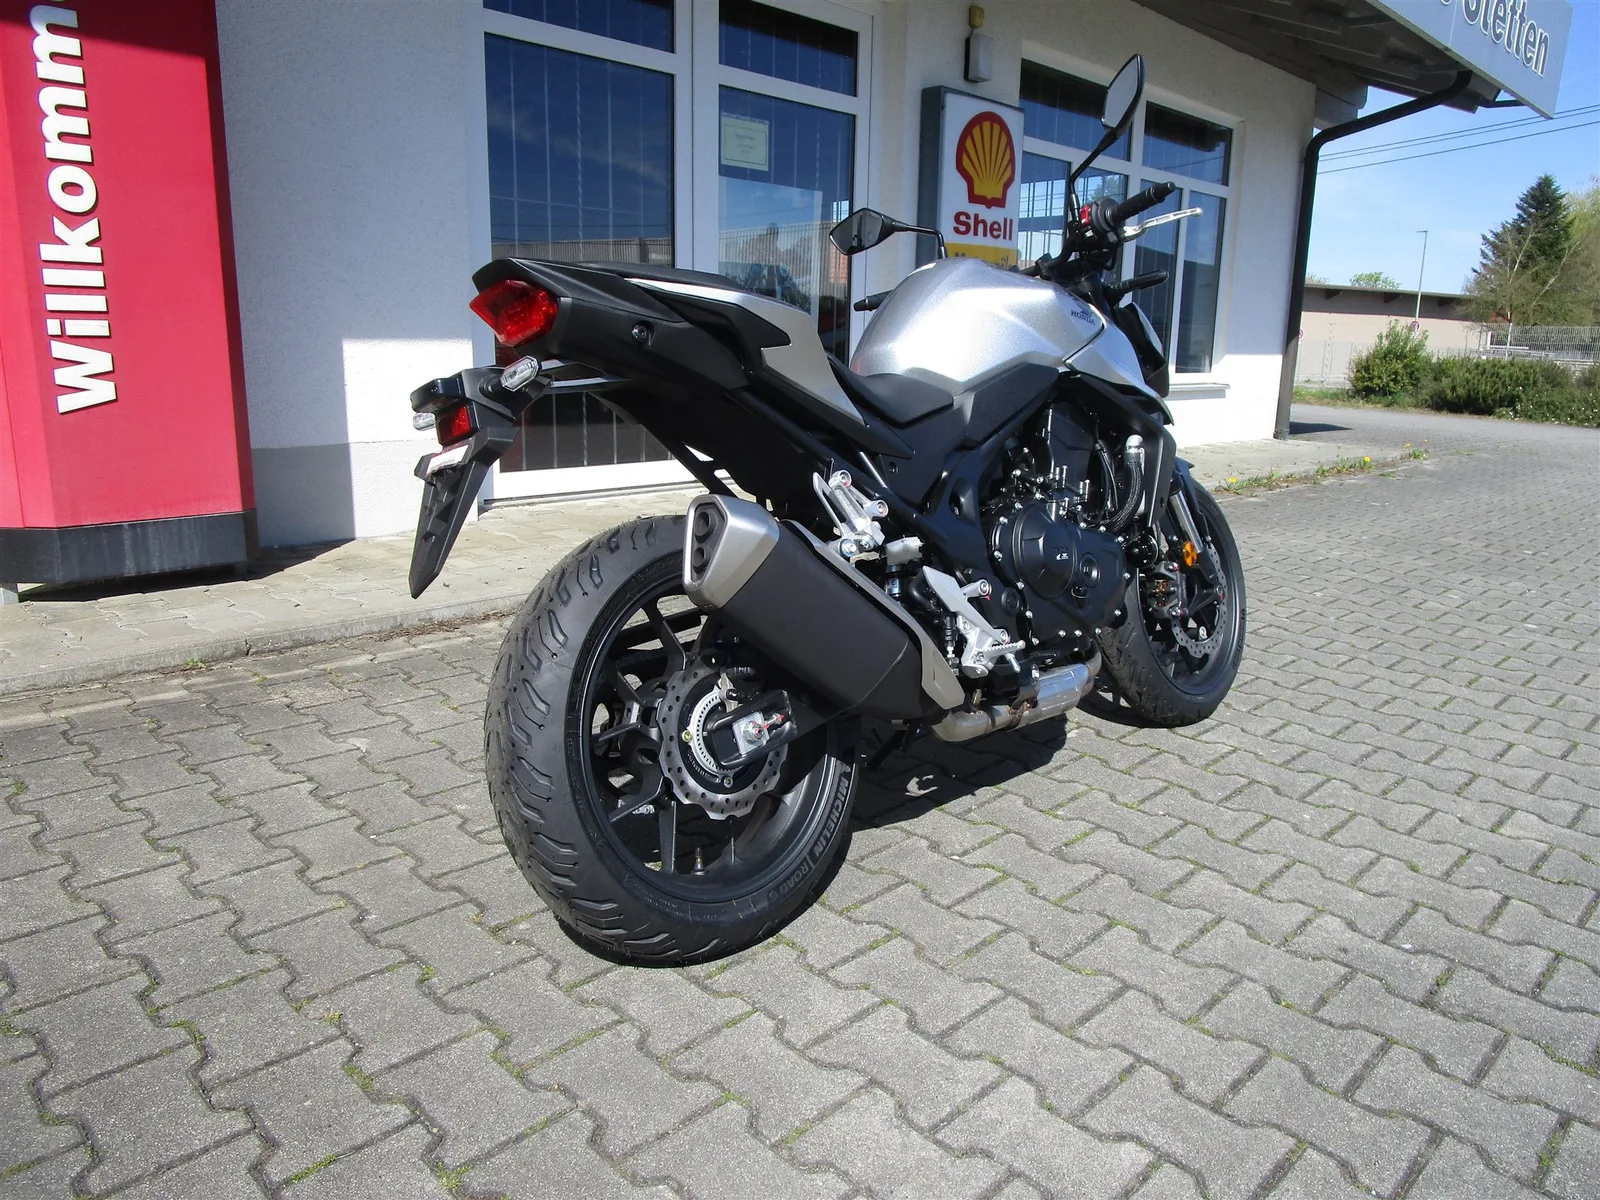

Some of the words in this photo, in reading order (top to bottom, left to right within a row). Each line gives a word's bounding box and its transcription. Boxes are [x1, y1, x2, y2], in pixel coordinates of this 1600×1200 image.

[29, 0, 117, 414] Willkomm
[953, 211, 1013, 241] Shell
[1070, 309, 1096, 325] HONDA
[812, 775, 849, 857] MICHELIN
